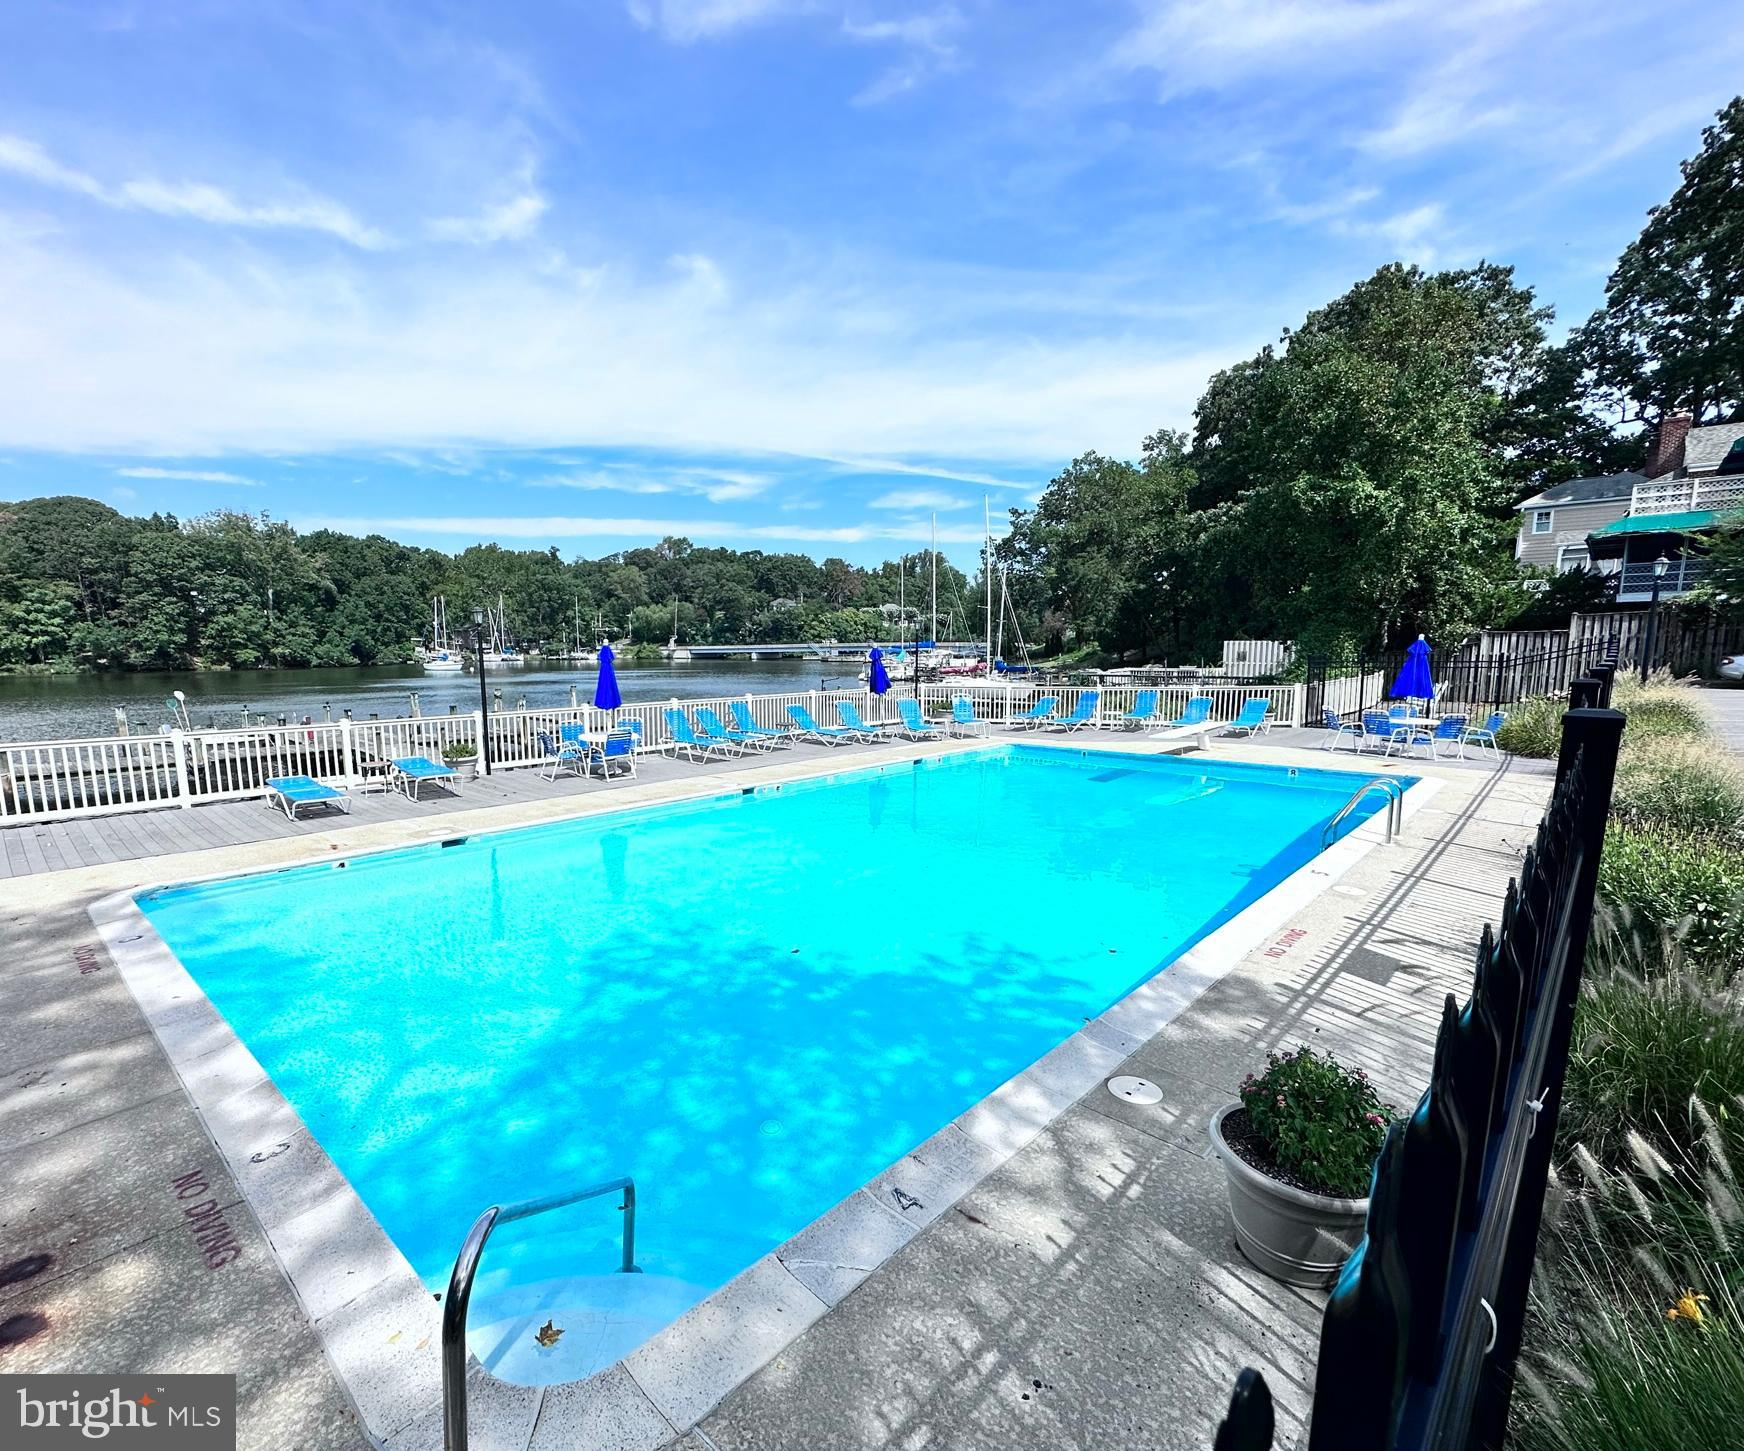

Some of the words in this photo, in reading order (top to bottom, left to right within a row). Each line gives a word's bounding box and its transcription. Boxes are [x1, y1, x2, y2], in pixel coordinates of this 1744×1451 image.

[1263, 947, 1287, 959] NO
[1275, 928, 1308, 948] DIVING
[171, 1169, 209, 1200] NO
[891, 1187, 924, 1211] 4
[184, 1198, 242, 1270] DIVING
